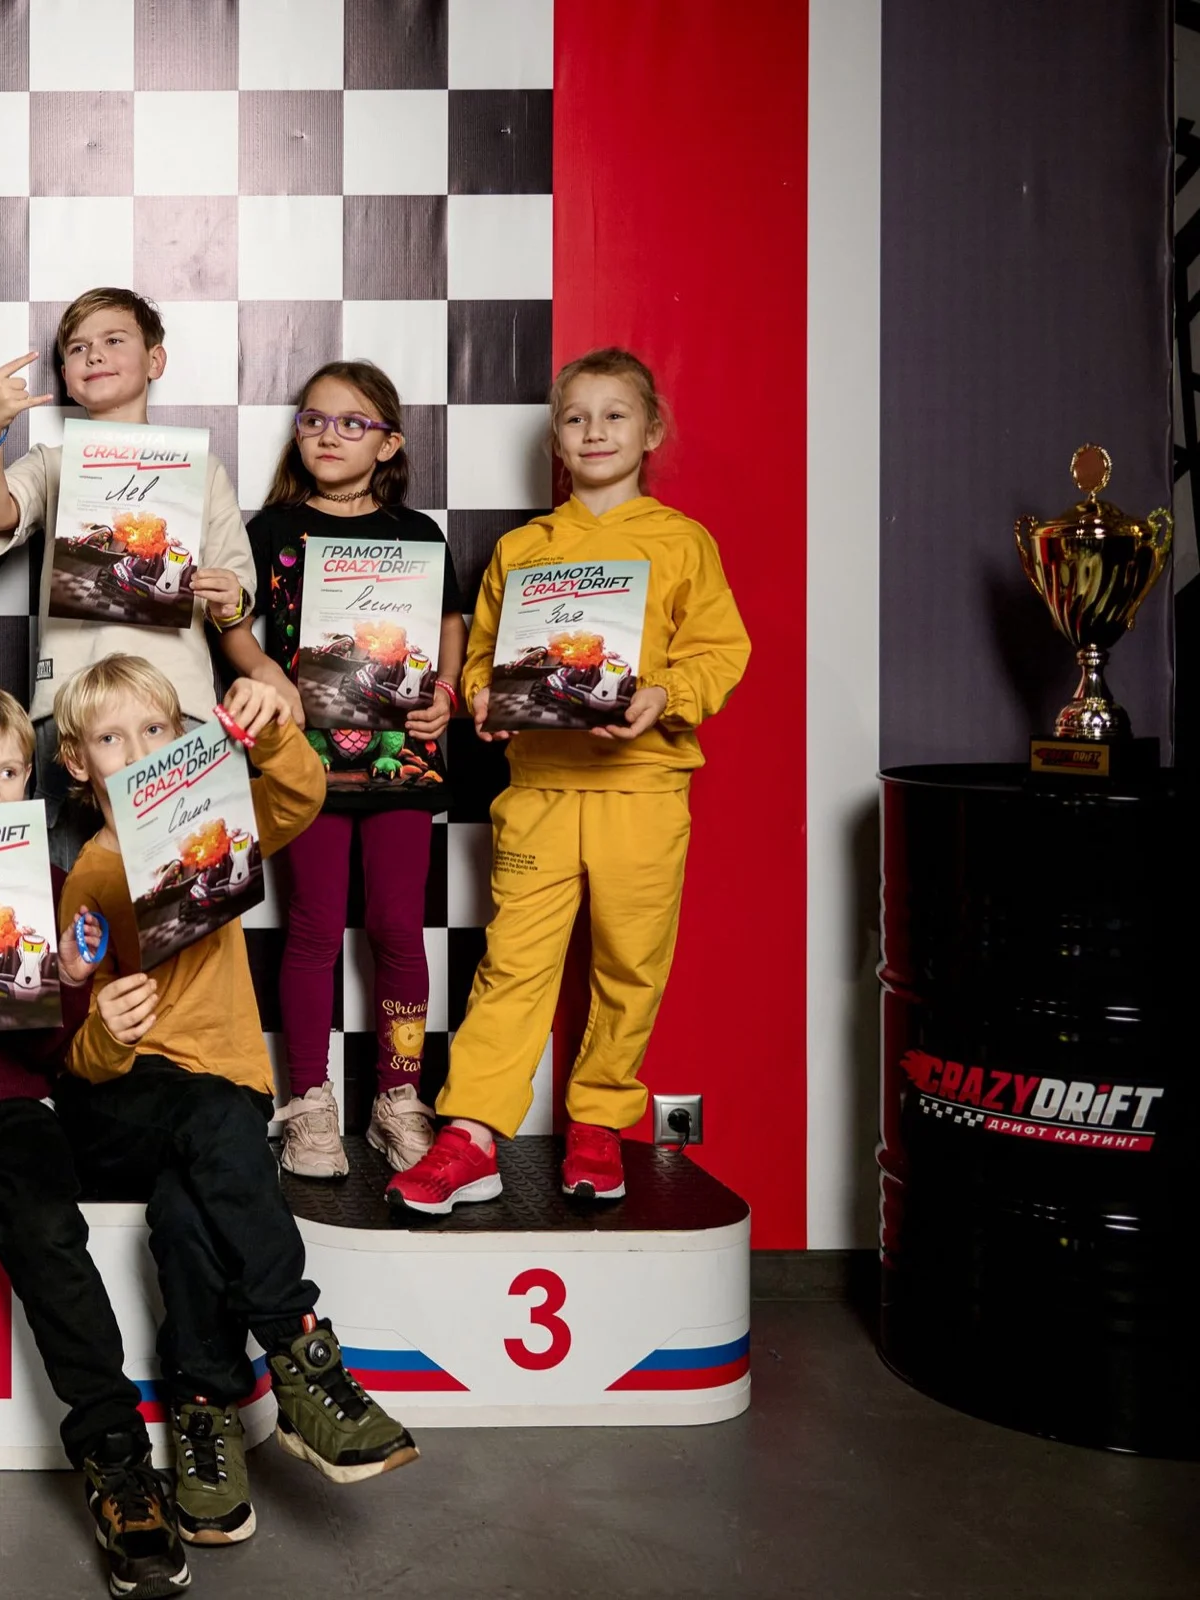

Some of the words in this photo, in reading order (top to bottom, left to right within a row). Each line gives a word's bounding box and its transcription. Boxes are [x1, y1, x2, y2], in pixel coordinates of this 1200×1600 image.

[82, 444, 190, 462] CRAZYDRIFT
[105, 474, 160, 502] Лев
[321, 546, 403, 559] ГРАМОТА
[324, 560, 431, 574] CRAZYDRIFT
[521, 566, 604, 587] ГРАМОТА
[522, 577, 634, 597] CRAZYDRIFT
[127, 736, 205, 794] ГРАМОТА
[132, 736, 231, 808] CRAZYDRIFT
[988, 1119, 1047, 1137] ДРИФТ
[1055, 1131, 1139, 1149] КАРТИНГ
[503, 1268, 571, 1371] 3
